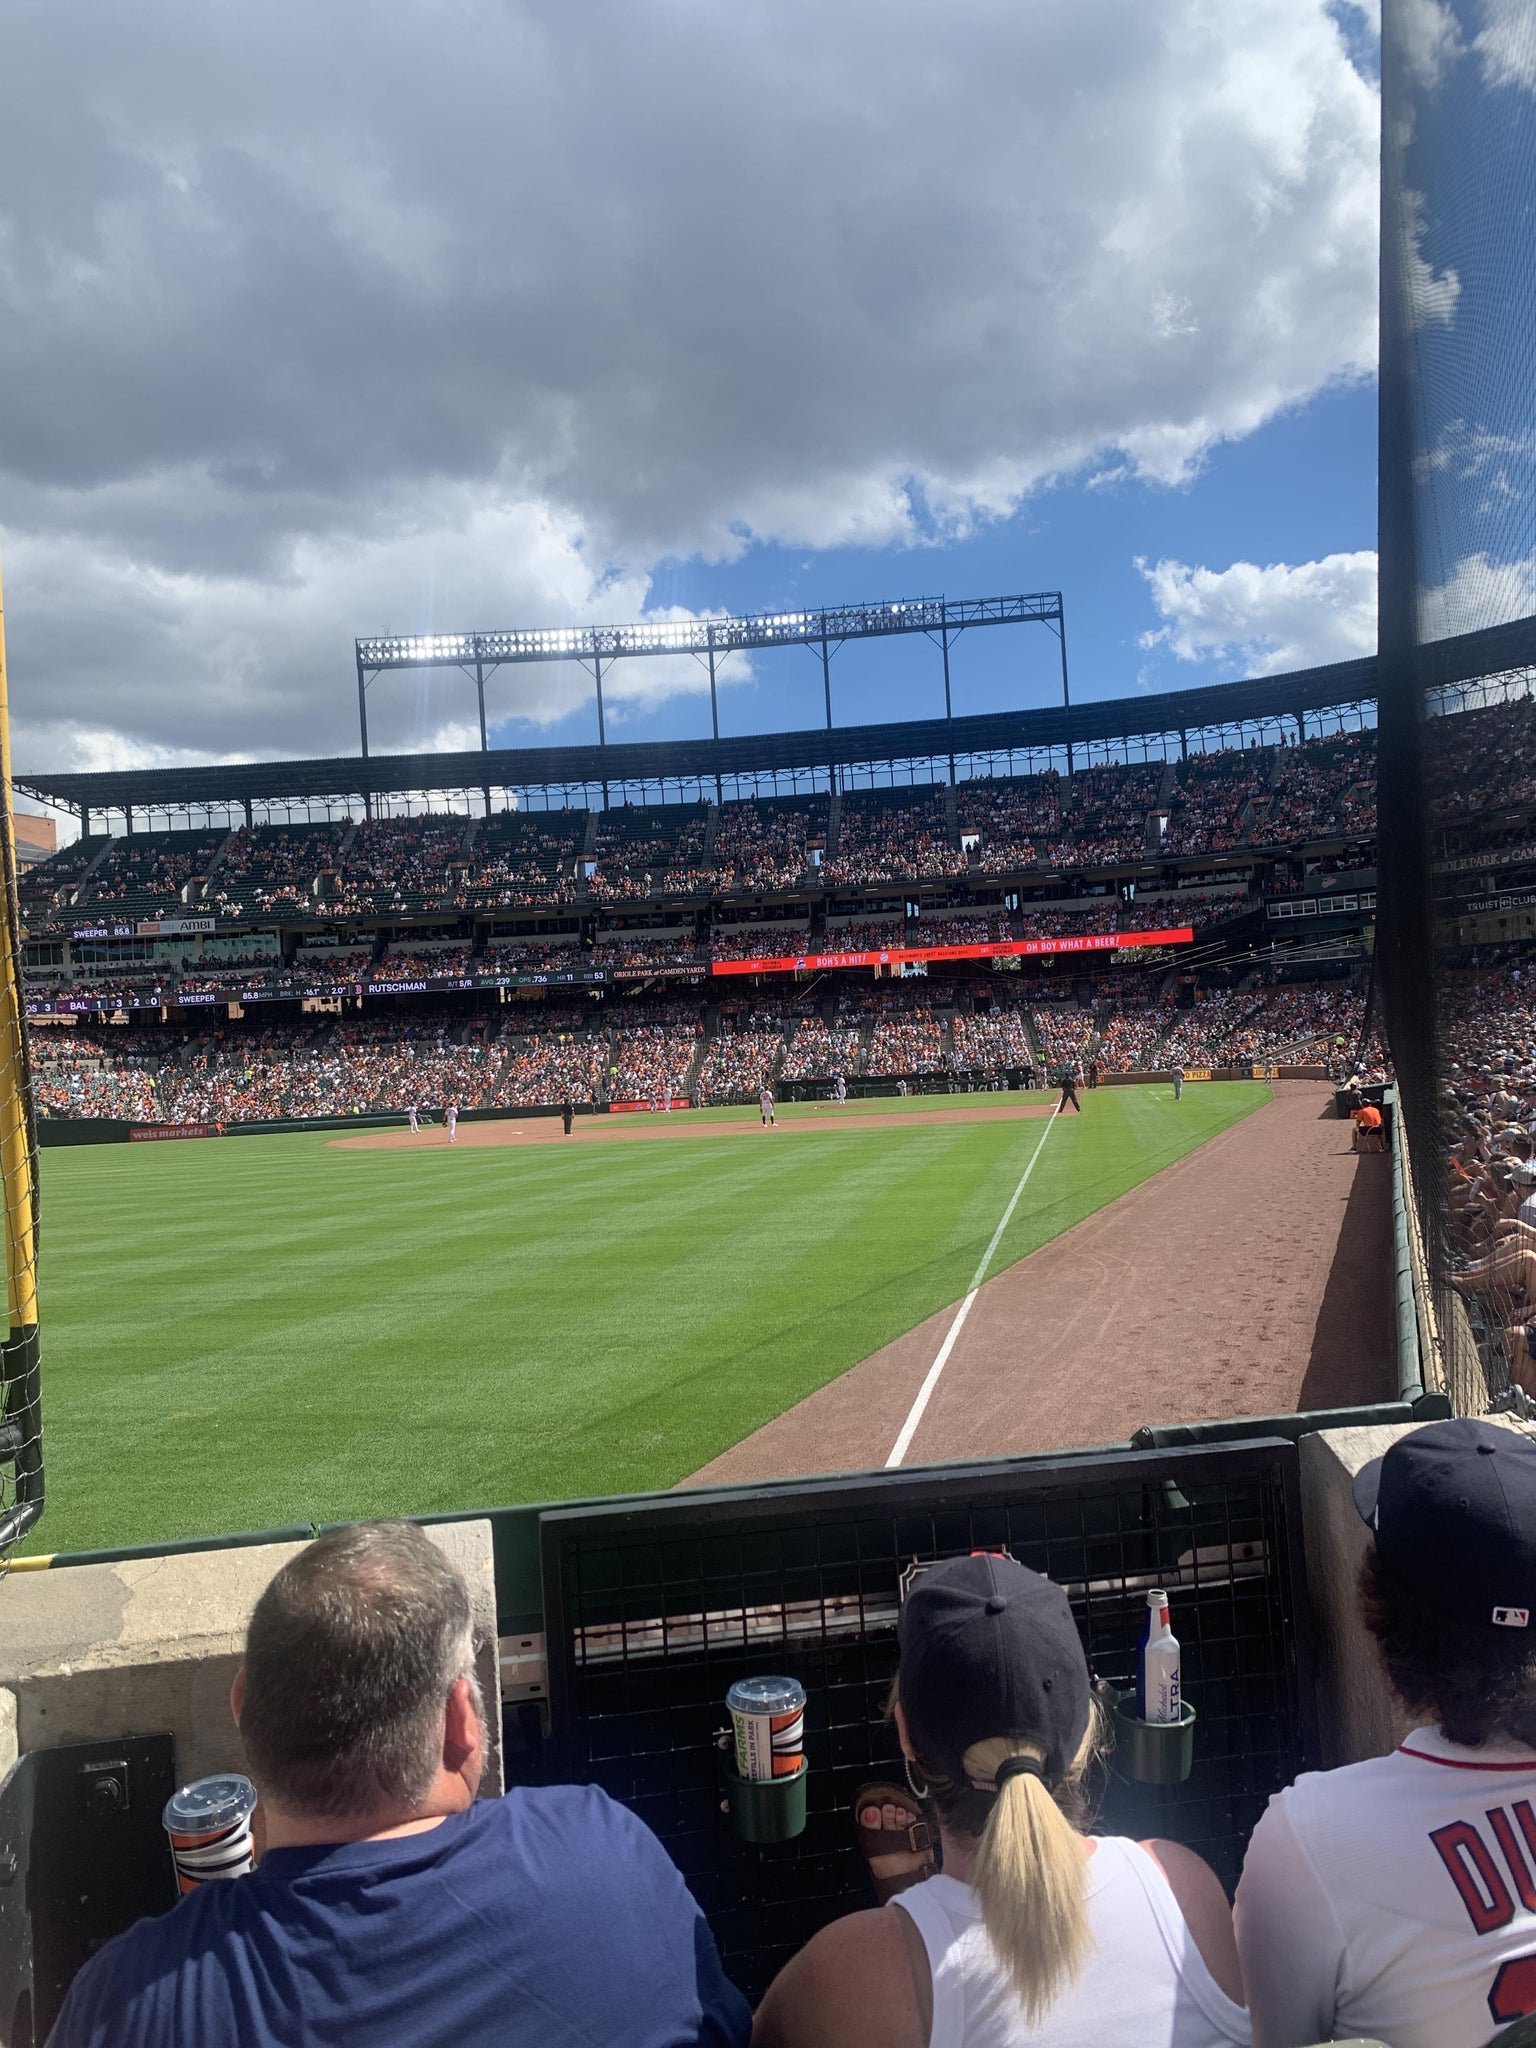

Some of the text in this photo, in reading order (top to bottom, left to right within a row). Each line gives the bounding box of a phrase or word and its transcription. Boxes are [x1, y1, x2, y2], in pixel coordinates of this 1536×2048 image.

[1470, 854, 1500, 868] PARK
[1467, 895, 1536, 911] TRUIST CLUB
[180, 920, 211, 930] AMBI
[73, 927, 130, 939] SWEEPER 85.8
[1026, 935, 1120, 952] OH BOY WHAT A BEER!
[816, 953, 866, 966] BOH'S A HIT!
[613, 970, 637, 978] ORIOLE
[637, 969, 653, 977] PARK
[660, 967, 687, 975] CAMDEN
[687, 966, 706, 974] YARDS
[368, 982, 427, 993] RUTSCHMAN
[459, 979, 472, 988] S/R
[495, 977, 511, 985] .239
[532, 975, 548, 983] .736
[594, 972, 604, 980] 53
[178, 994, 215, 1004] SWEEPER
[242, 991, 259, 1000] 85.8
[44, 1003, 51, 1012] 3
[70, 1001, 88, 1010] BAL
[116, 999, 122, 1007] 3
[133, 998, 140, 1006] 2
[1192, 1070, 1211, 1078] PIZZA
[133, 1127, 204, 1139] weis markets
[735, 1715, 749, 1770] FARMS
[749, 1742, 756, 1751] IN
